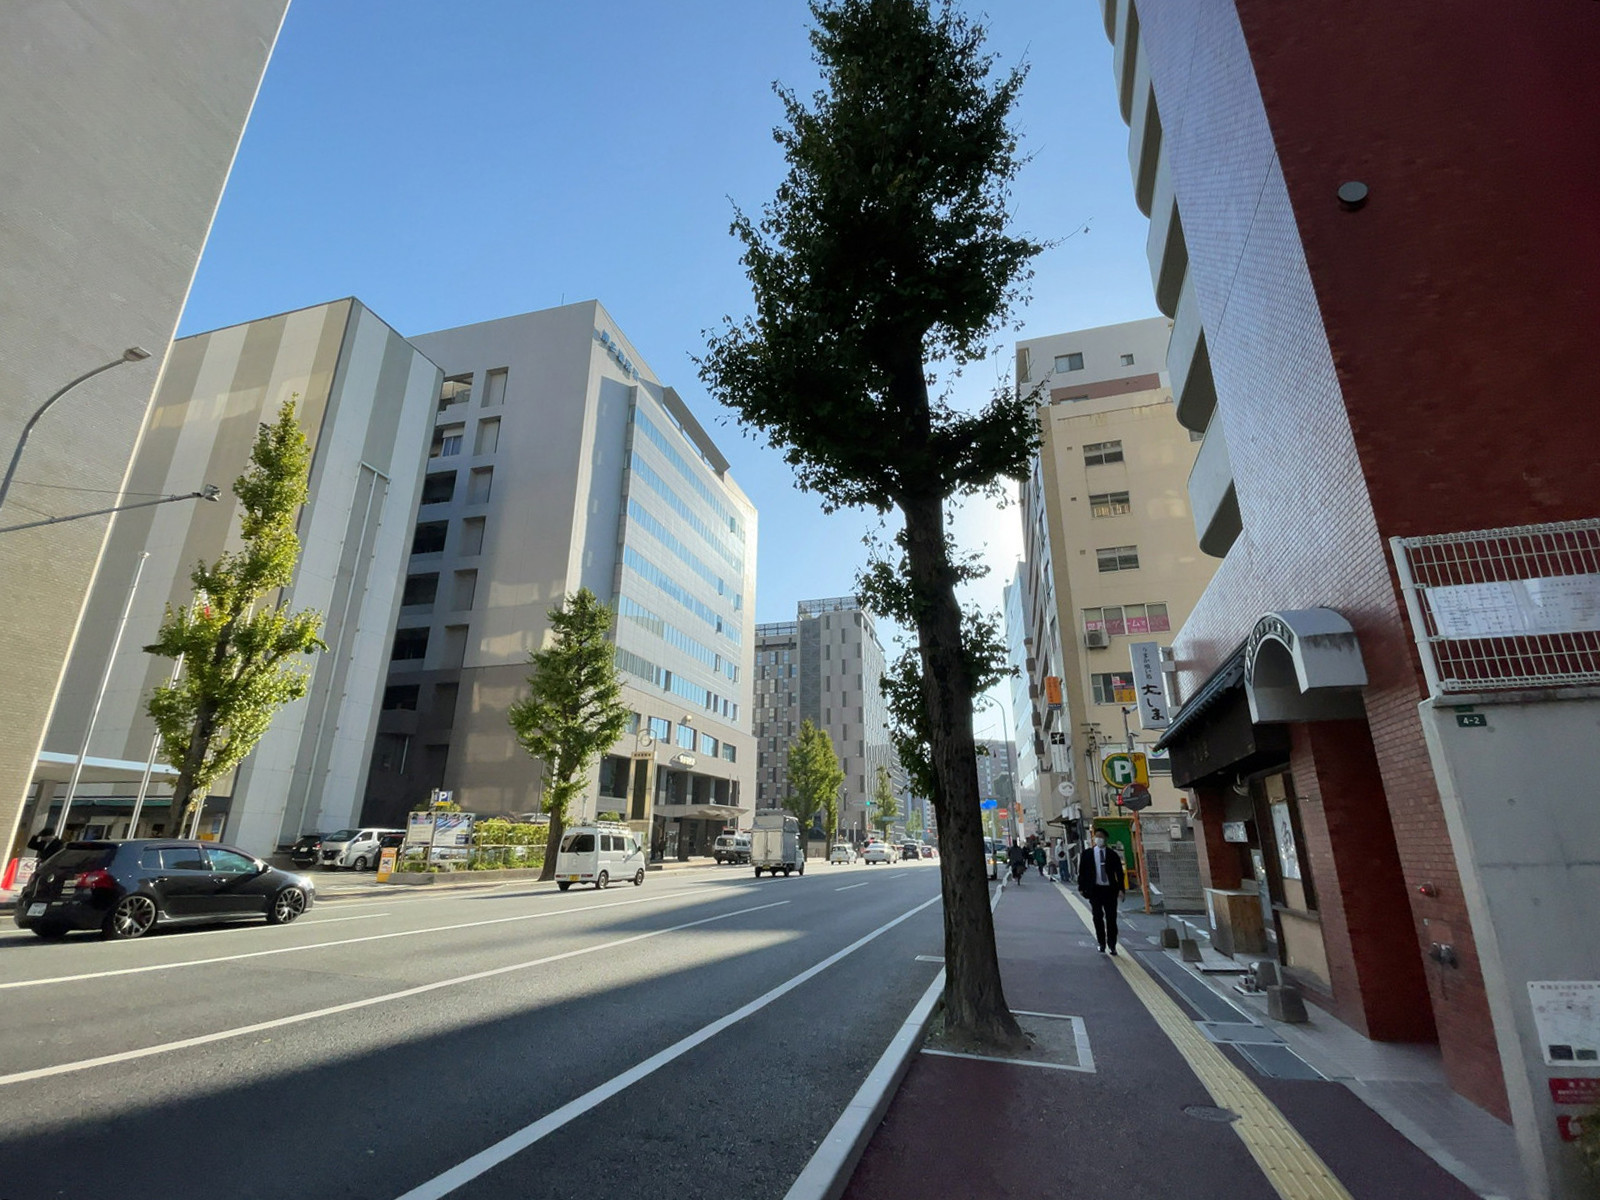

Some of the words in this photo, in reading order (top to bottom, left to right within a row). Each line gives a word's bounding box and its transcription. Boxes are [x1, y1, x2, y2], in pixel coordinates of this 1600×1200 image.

[1141, 684, 1165, 721] 大しま
[1463, 717, 1480, 725] 4-2
[1113, 760, 1131, 782] P
[438, 791, 448, 802] P
